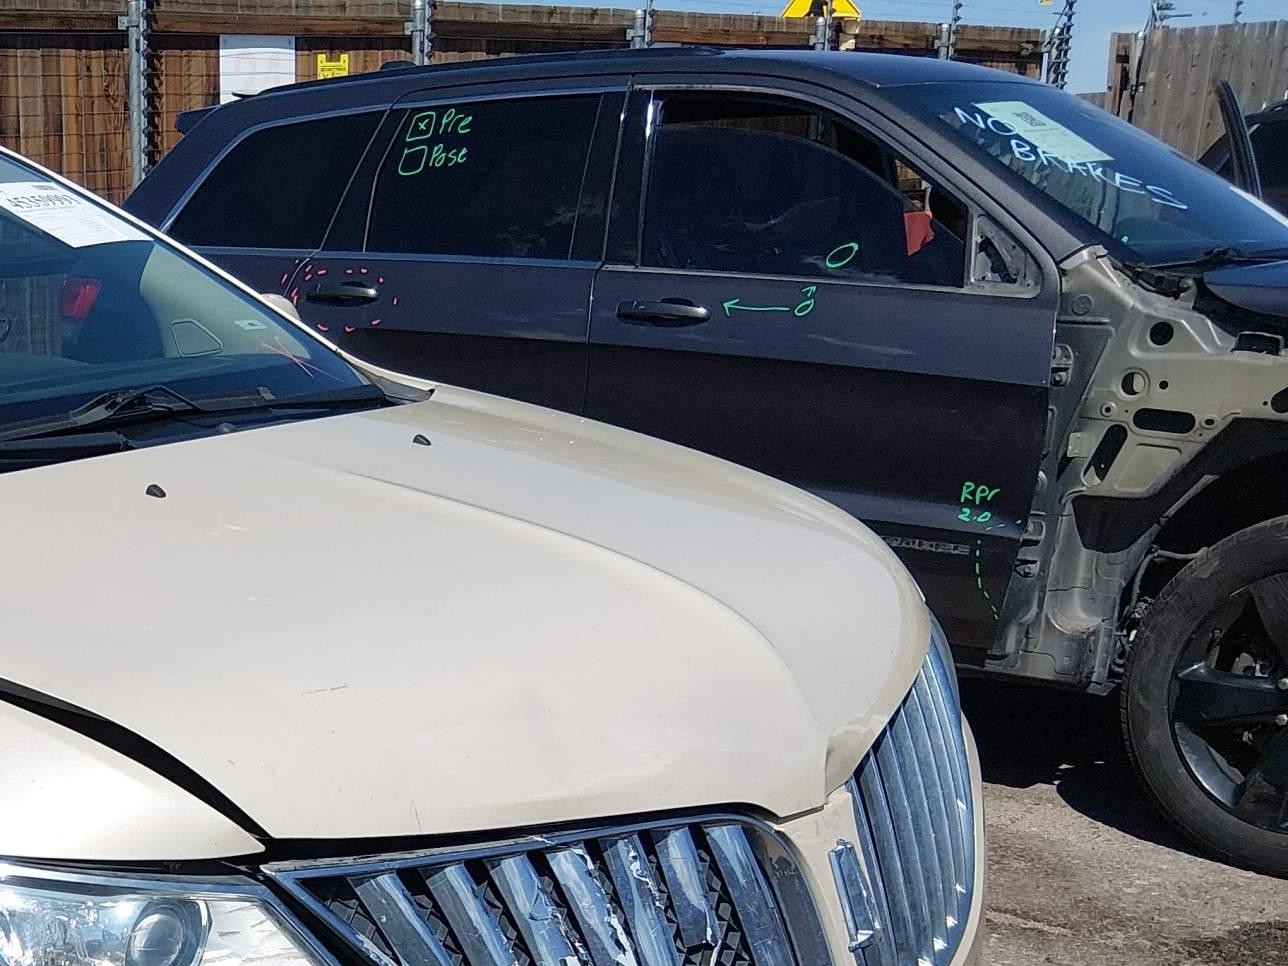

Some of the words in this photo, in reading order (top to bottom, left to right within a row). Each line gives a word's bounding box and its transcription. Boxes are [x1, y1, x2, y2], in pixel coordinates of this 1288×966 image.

[439, 108, 473, 134] Pre
[953, 106, 1017, 136] NO
[1010, 139, 1189, 210] BRAKES
